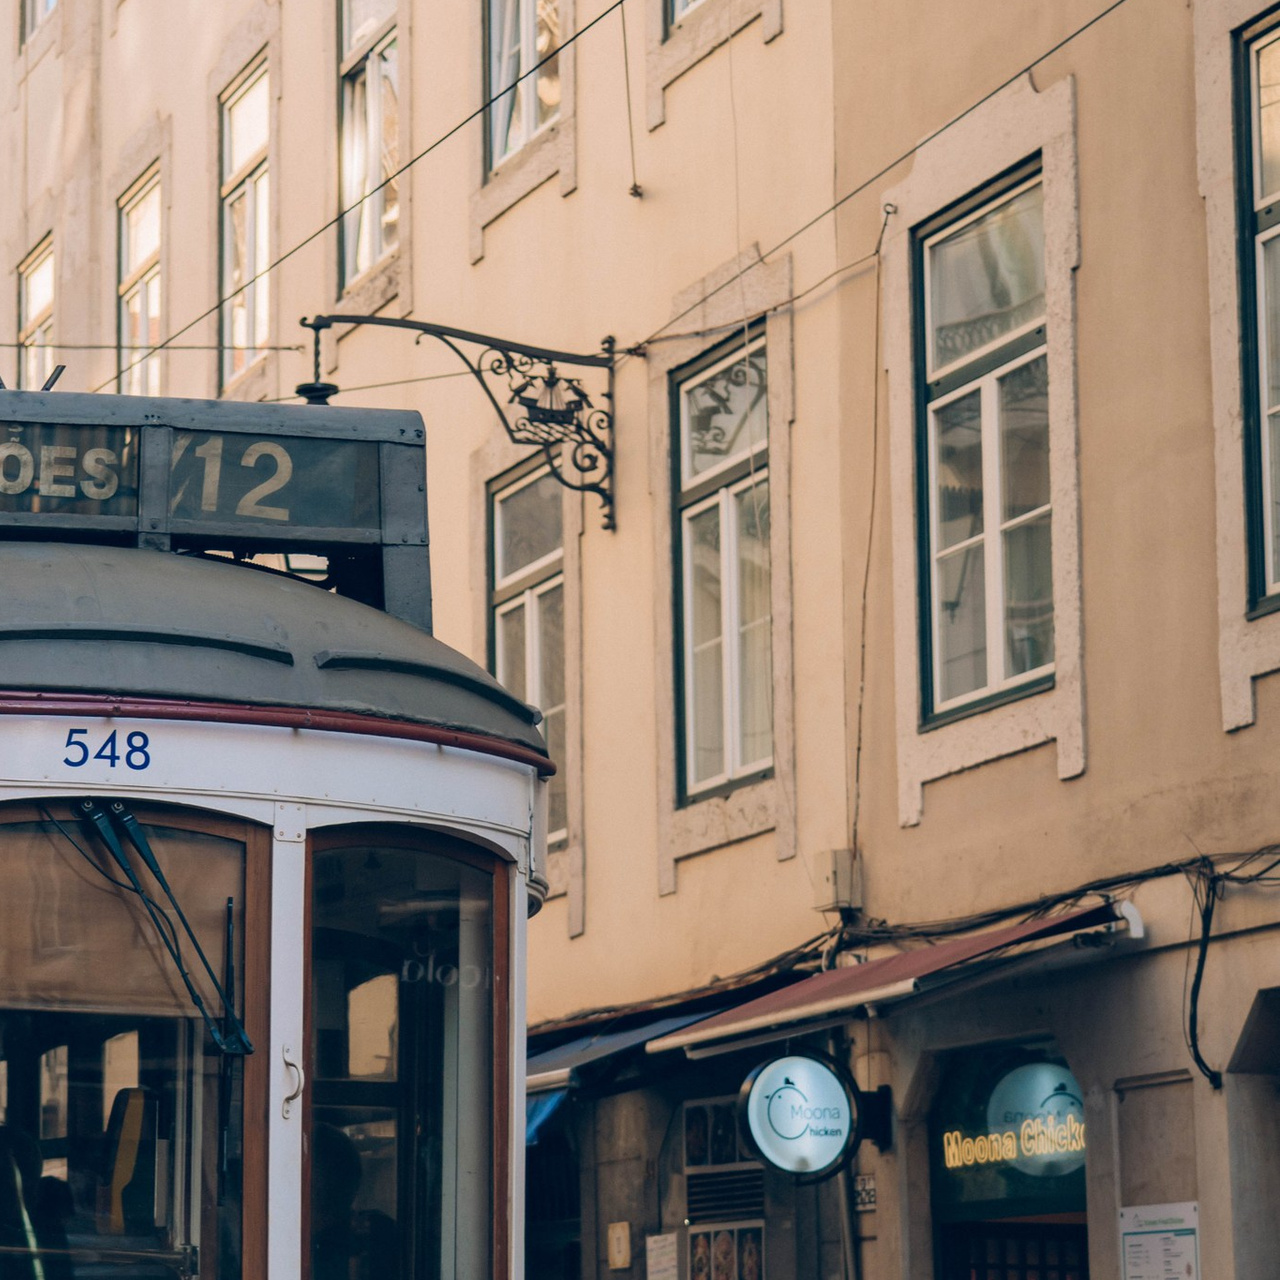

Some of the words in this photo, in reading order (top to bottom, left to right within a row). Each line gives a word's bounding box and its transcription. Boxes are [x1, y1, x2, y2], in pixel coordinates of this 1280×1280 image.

[195, 435, 294, 521] 12
[63, 728, 151, 771] 548
[790, 1105, 841, 1120] Moona
[943, 1130, 1018, 1169] Moona
